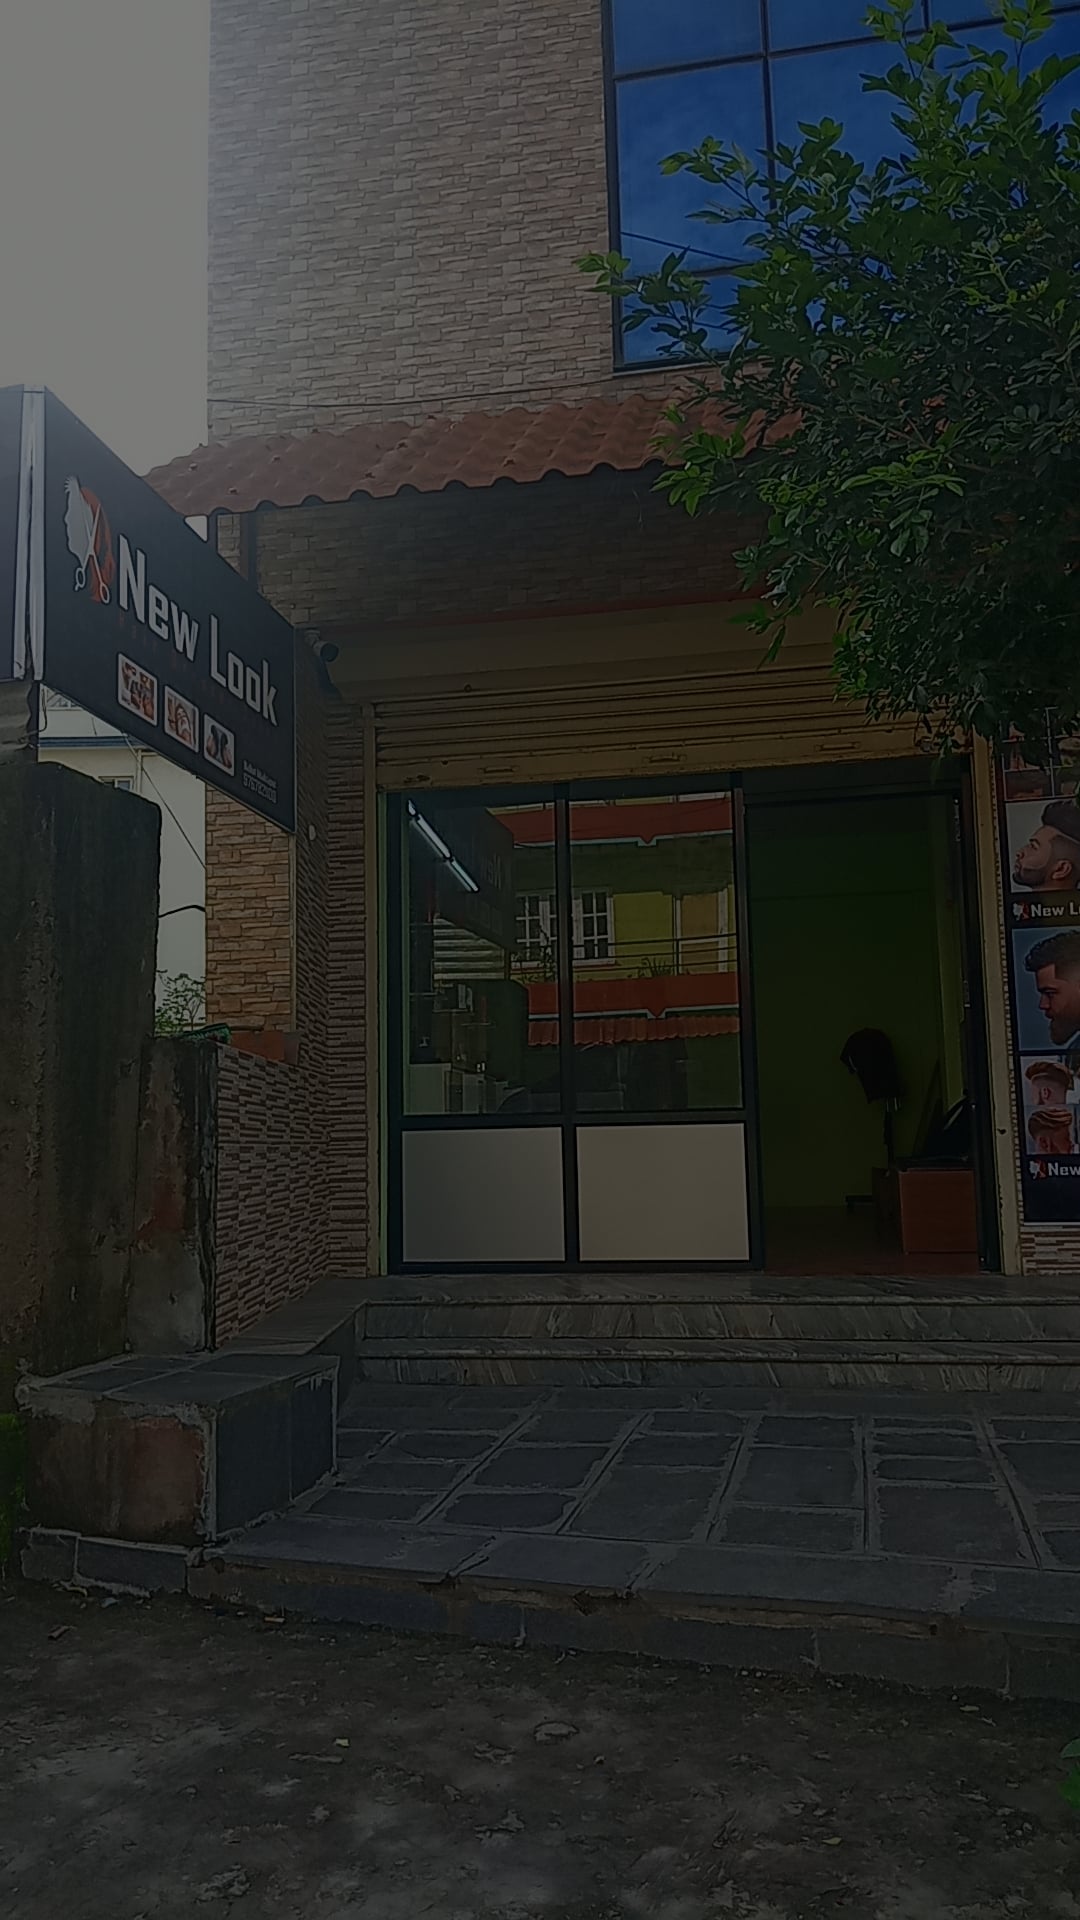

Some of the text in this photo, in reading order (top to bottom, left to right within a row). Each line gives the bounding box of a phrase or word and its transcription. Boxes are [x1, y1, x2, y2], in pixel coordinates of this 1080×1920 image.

[119, 534, 199, 662] New
[210, 613, 278, 727] Look
[1030, 901, 1080, 918] New L
[1047, 1162, 1080, 1177] New
